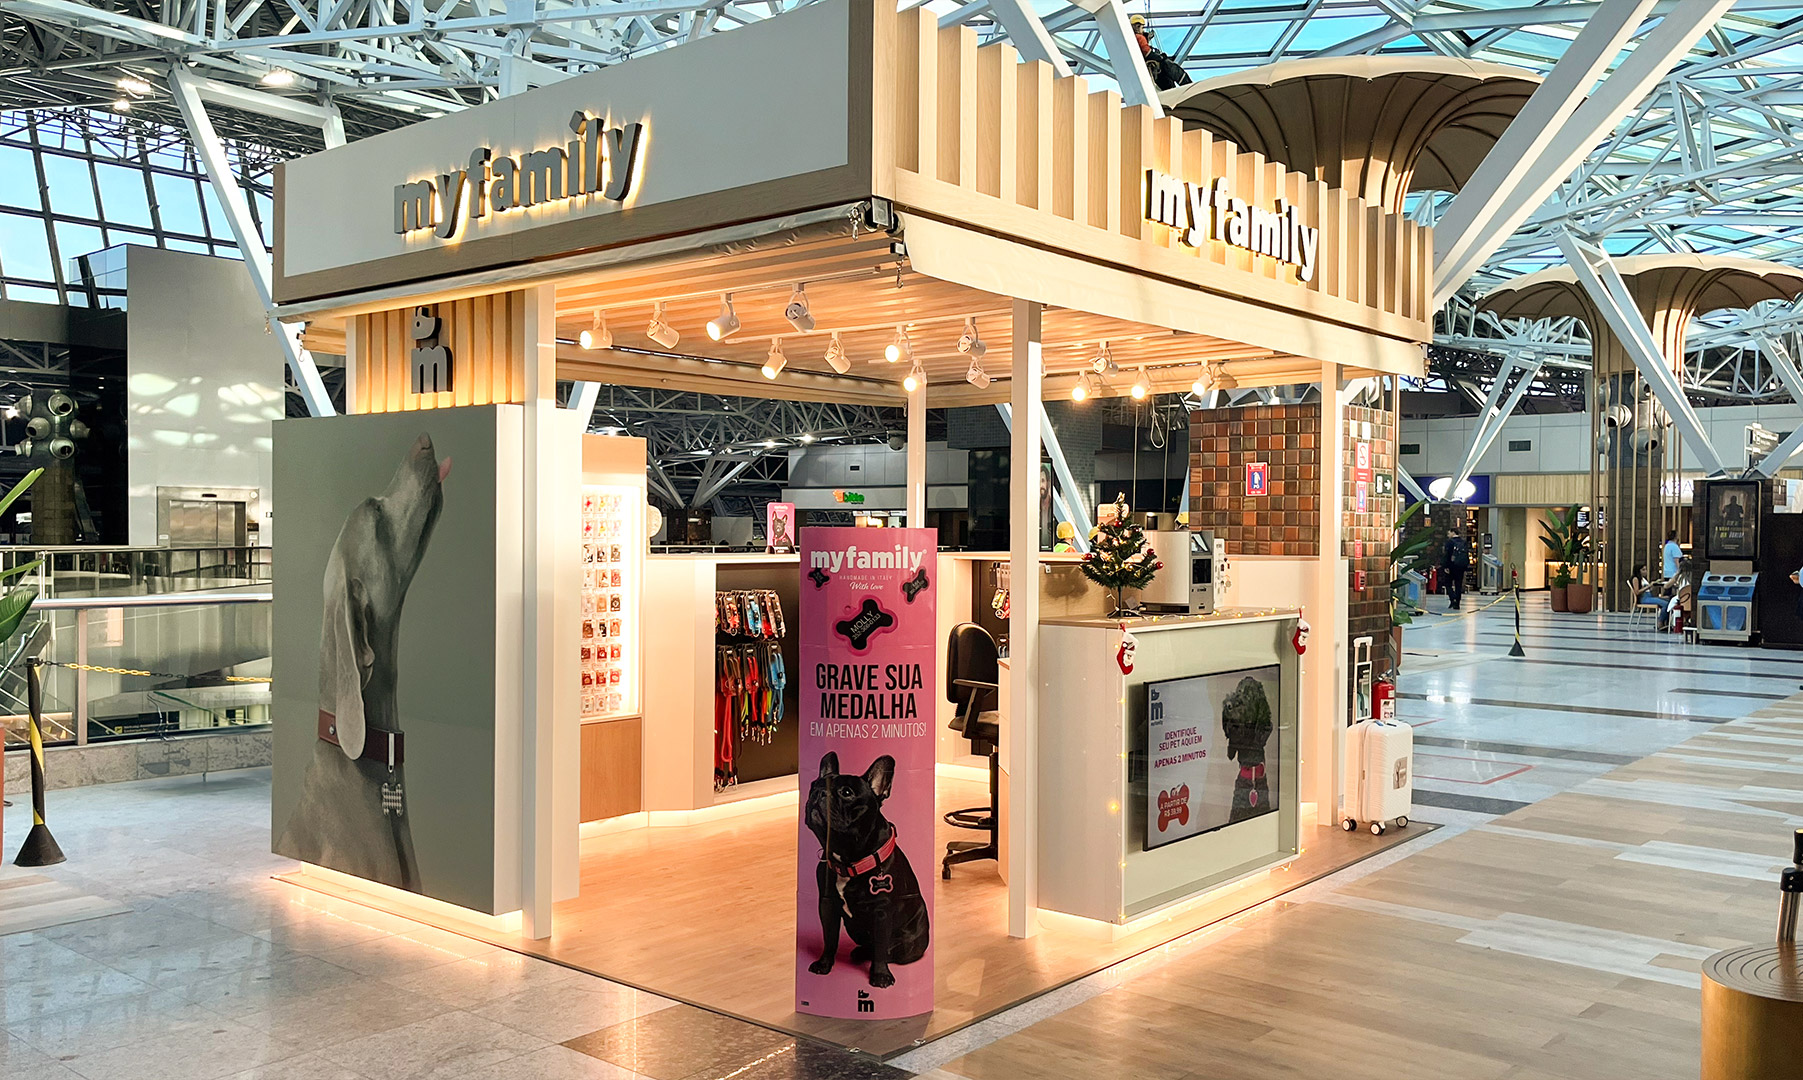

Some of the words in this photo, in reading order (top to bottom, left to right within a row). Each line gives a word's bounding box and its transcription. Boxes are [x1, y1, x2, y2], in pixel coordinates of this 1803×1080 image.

[394, 110, 643, 238] myfamily
[1146, 169, 1318, 282] myfamily
[849, 582, 869, 590] With
[870, 582, 884, 590] love
[850, 610, 874, 634] MOLLY
[816, 663, 879, 690] GRAVE
[885, 664, 923, 690] SUA
[820, 693, 918, 719] MEDALHA
[810, 722, 824, 737] EM
[826, 723, 869, 739] APENAS
[871, 724, 879, 739] 2
[881, 722, 927, 738] MINUTOS!
[1165, 726, 1197, 740] IDENTIFIQUE
[1159, 741, 1170, 751] SEU
[1170, 739, 1180, 749] PET
[1181, 737, 1194, 746] AQUI
[1194, 735, 1203, 744] EM
[1154, 756, 1177, 768] APENAS
[1177, 755, 1182, 763] 2
[1182, 749, 1206, 762] MINUTOS
